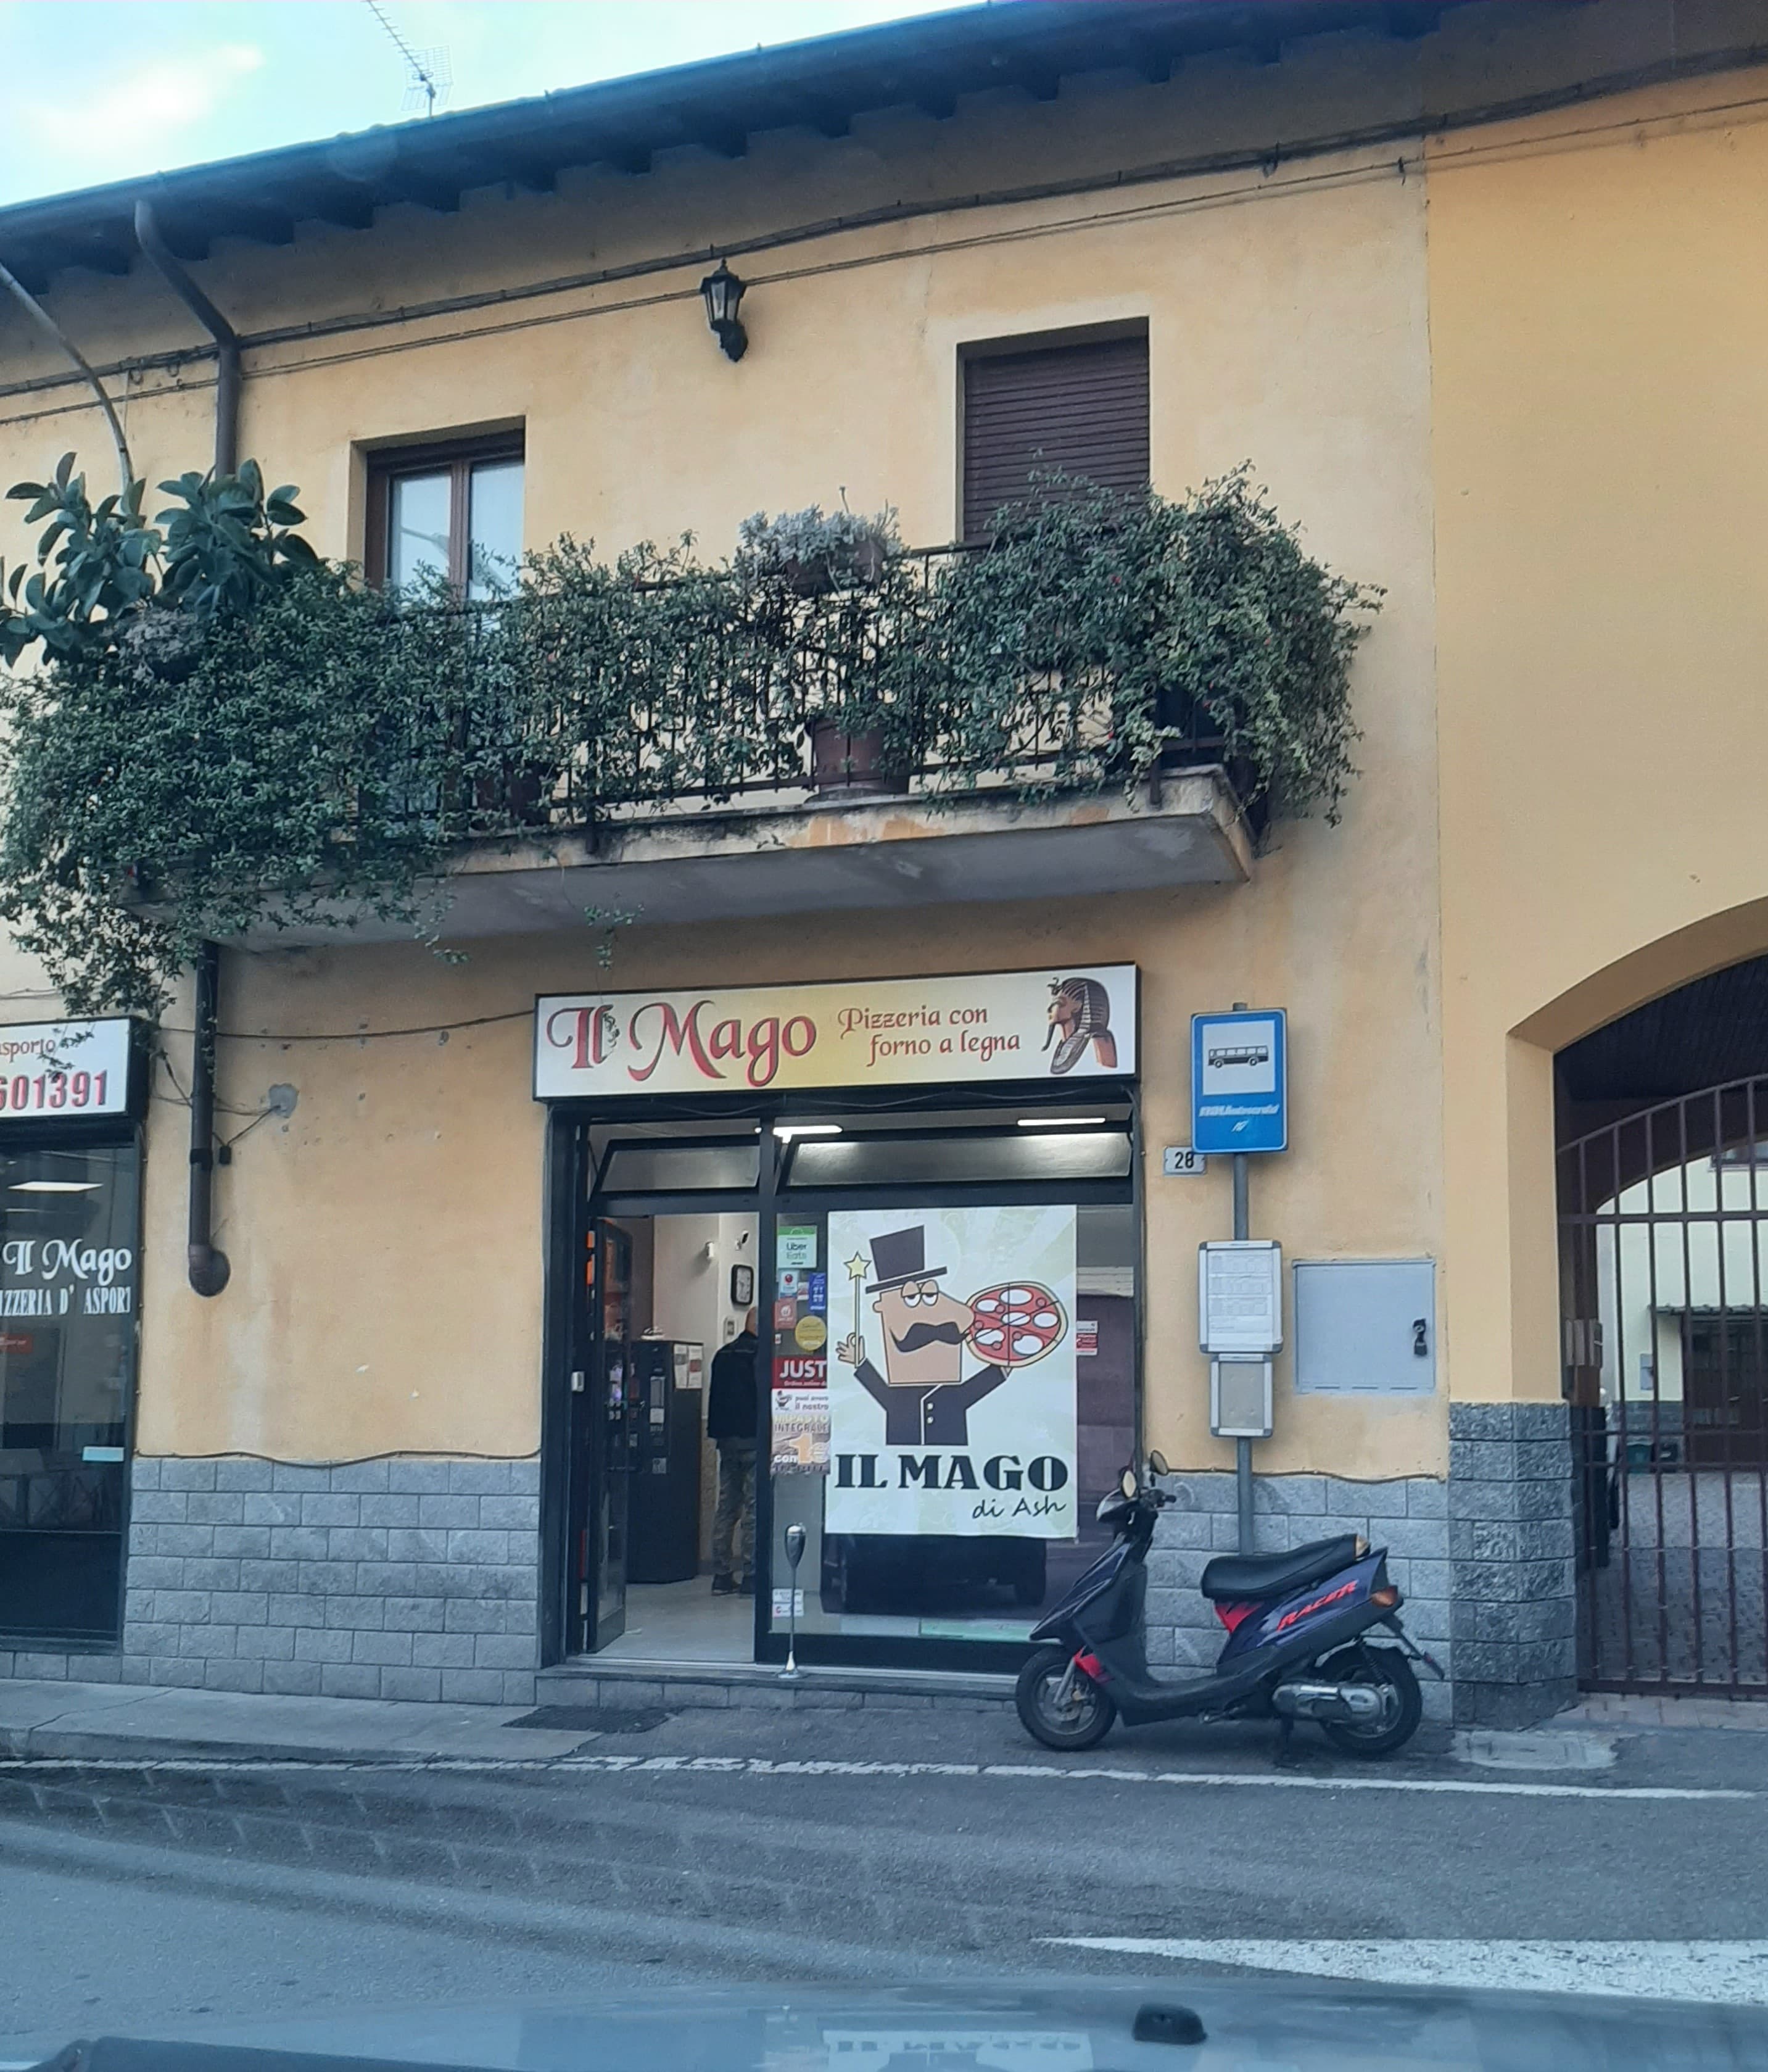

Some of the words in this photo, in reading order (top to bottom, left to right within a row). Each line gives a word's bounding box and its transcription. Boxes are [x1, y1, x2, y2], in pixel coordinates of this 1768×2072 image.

[837, 1005, 941, 1040] Pizzeria
[949, 1008, 988, 1025] con
[0, 1039, 56, 1063] sporto
[546, 1004, 613, 1069] Il
[627, 1000, 817, 1087] Mago
[866, 1033, 932, 1067] forno
[939, 1037, 953, 1053] a
[960, 1029, 1021, 1062] legna
[1175, 1151, 1194, 1169] 28
[787, 1242, 808, 1250] Uber
[2, 1240, 36, 1275] Il
[41, 1238, 133, 1287] Mago
[779, 1359, 827, 1379] JUST
[774, 1454, 798, 1464] con
[835, 1454, 888, 1488] IL
[898, 1454, 1068, 1492] MAGO
[972, 1498, 1005, 1520] di
[1012, 1495, 1067, 1517] Ash
